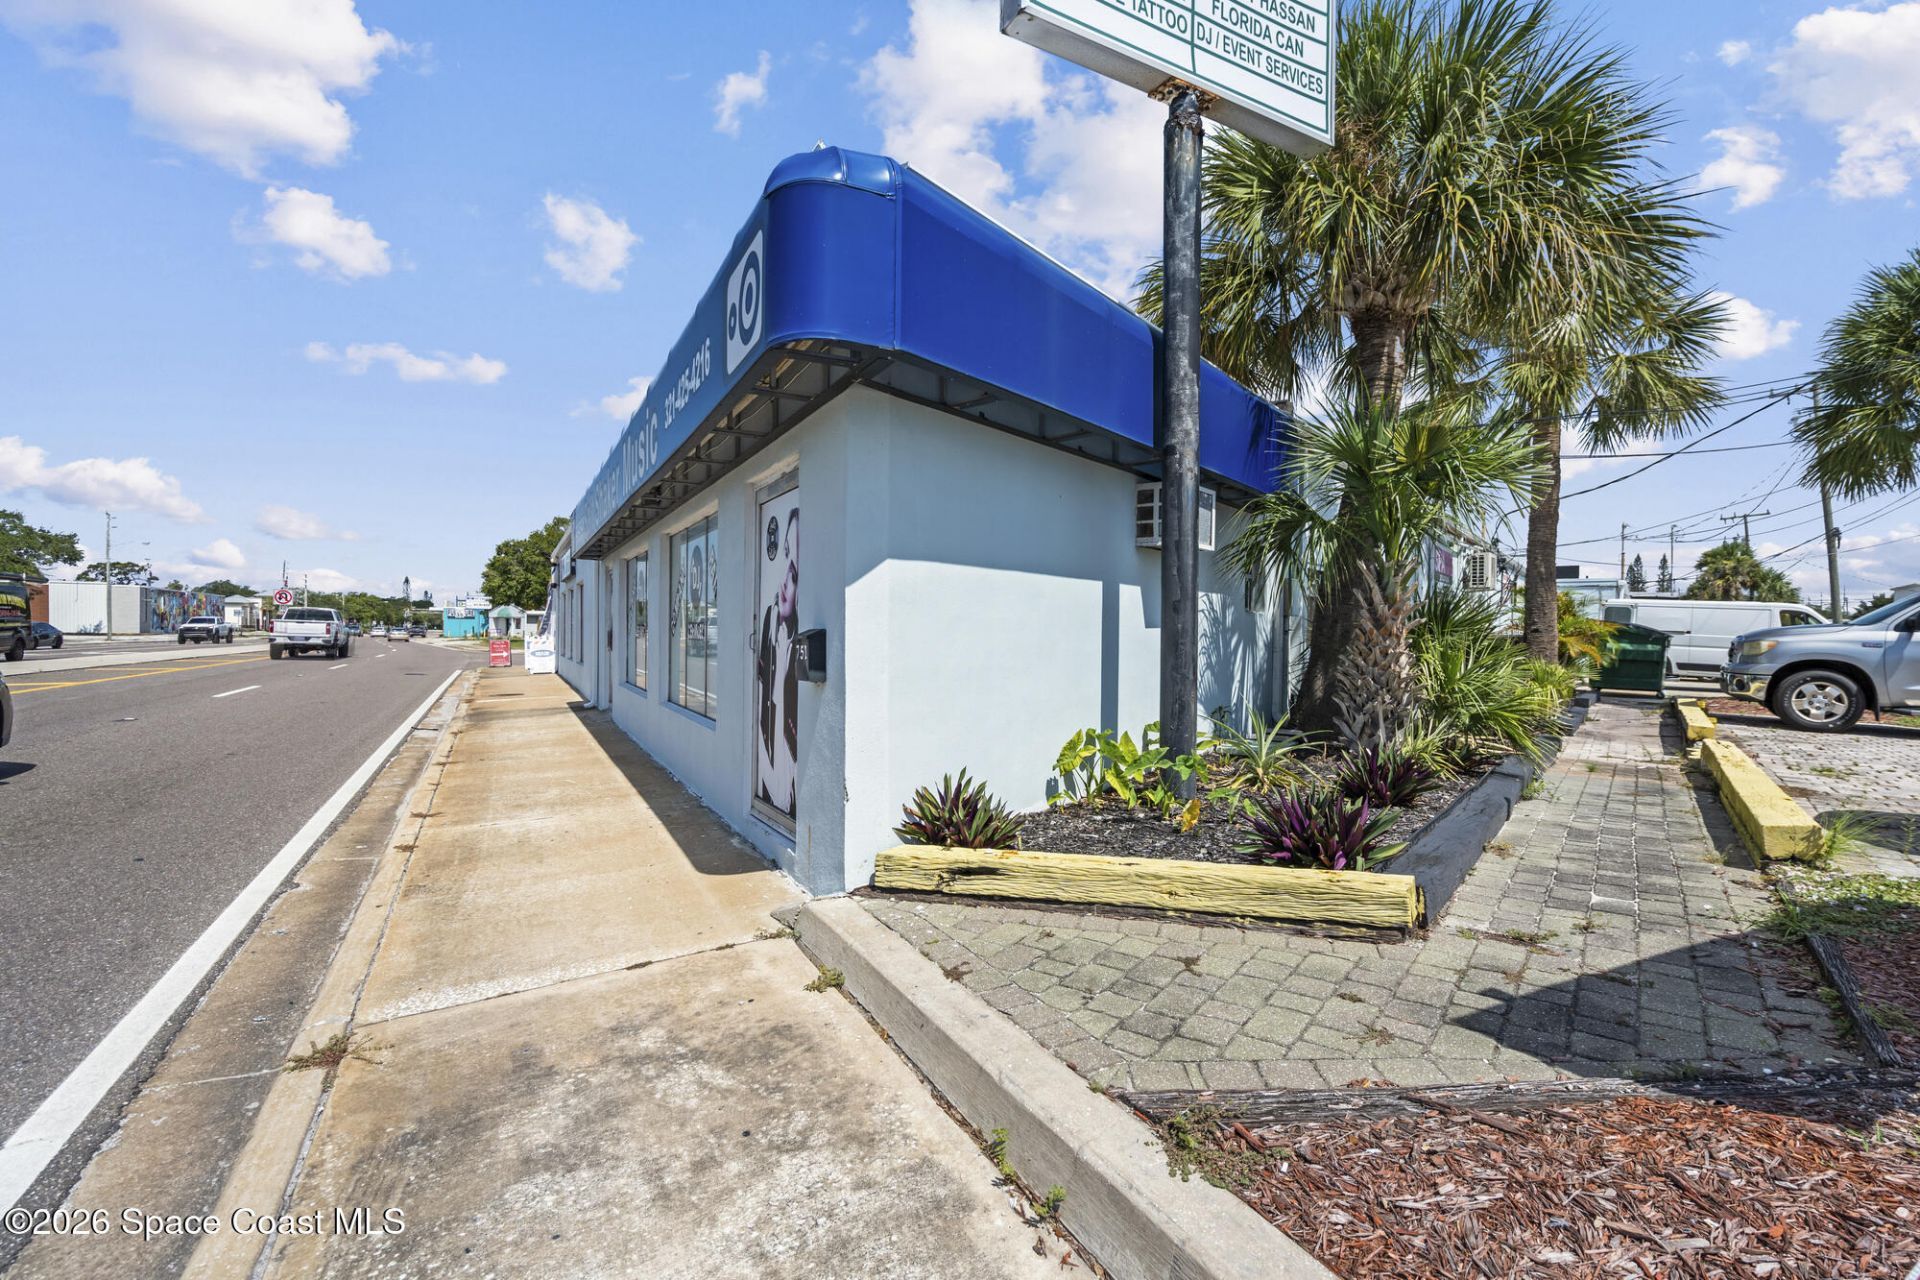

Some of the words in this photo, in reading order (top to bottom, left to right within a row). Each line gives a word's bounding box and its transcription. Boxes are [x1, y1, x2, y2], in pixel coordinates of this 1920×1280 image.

[1212, 0, 1273, 44] FLORIDA
[1276, 30, 1304, 58] CAN
[1261, 0, 1316, 33] HASSAN
[1197, 21, 1212, 45] DJ
[1223, 34, 1263, 68] EVENT
[1265, 55, 1323, 95] SERVICES
[622, 407, 658, 497] Music
[664, 336, 710, 430] 321-425-4216
[796, 644, 808, 661] 751
